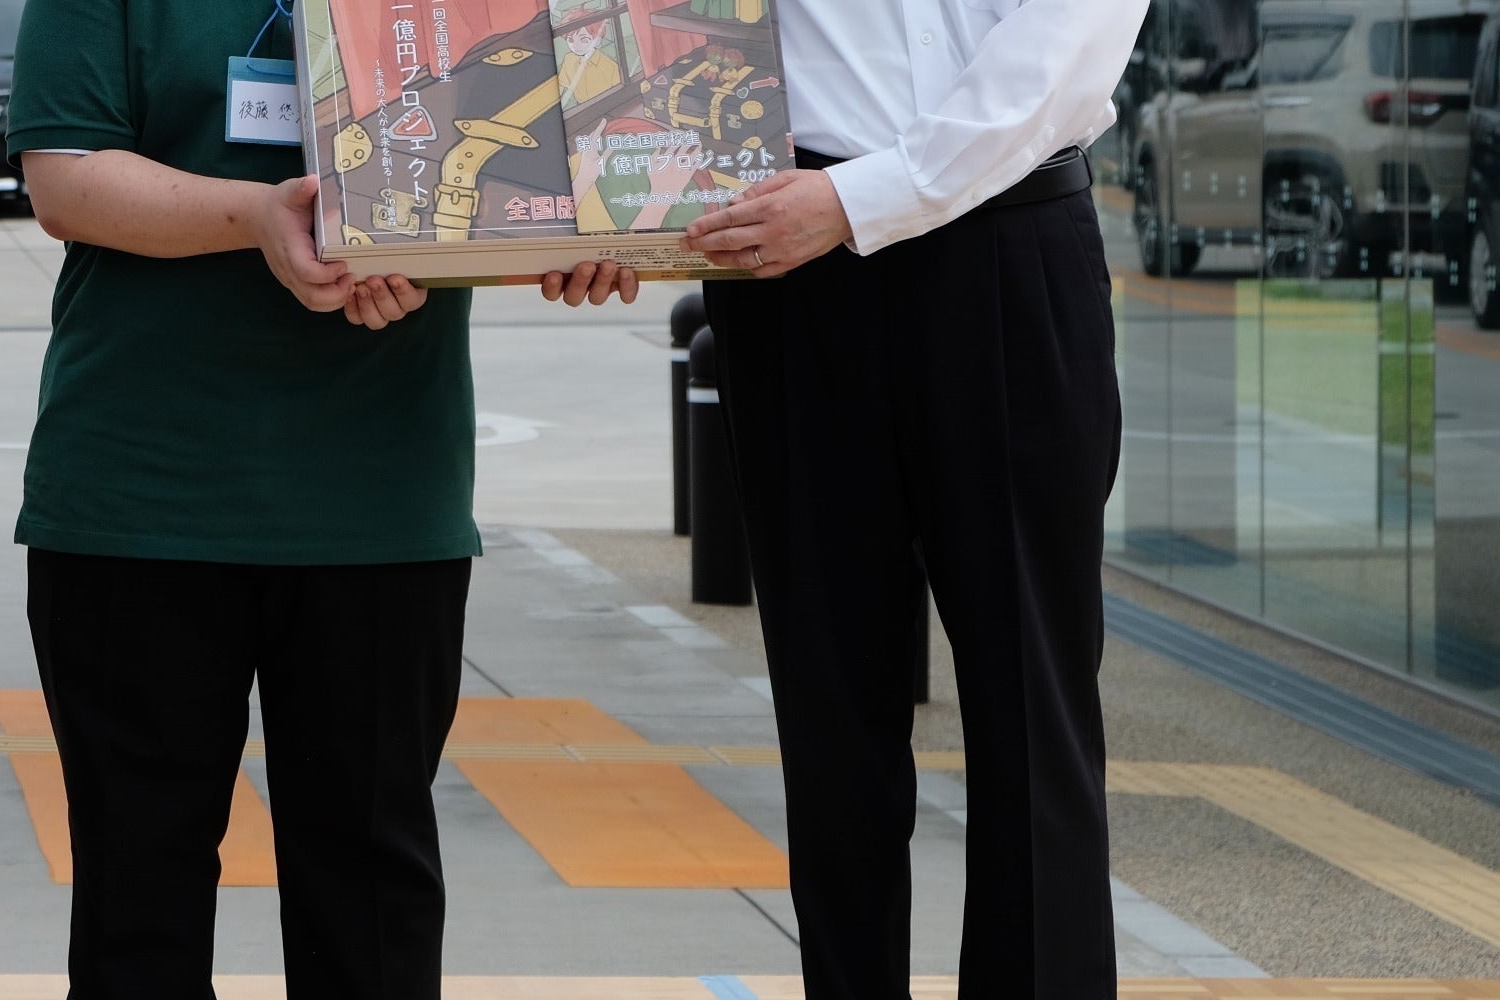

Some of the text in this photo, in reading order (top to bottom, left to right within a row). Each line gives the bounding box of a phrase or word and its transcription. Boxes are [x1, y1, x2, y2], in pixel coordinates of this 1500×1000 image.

[239, 100, 269, 120] 後藤
[390, 4, 429, 202] 一億円プロジェクト
[504, 195, 576, 221] 全国版
